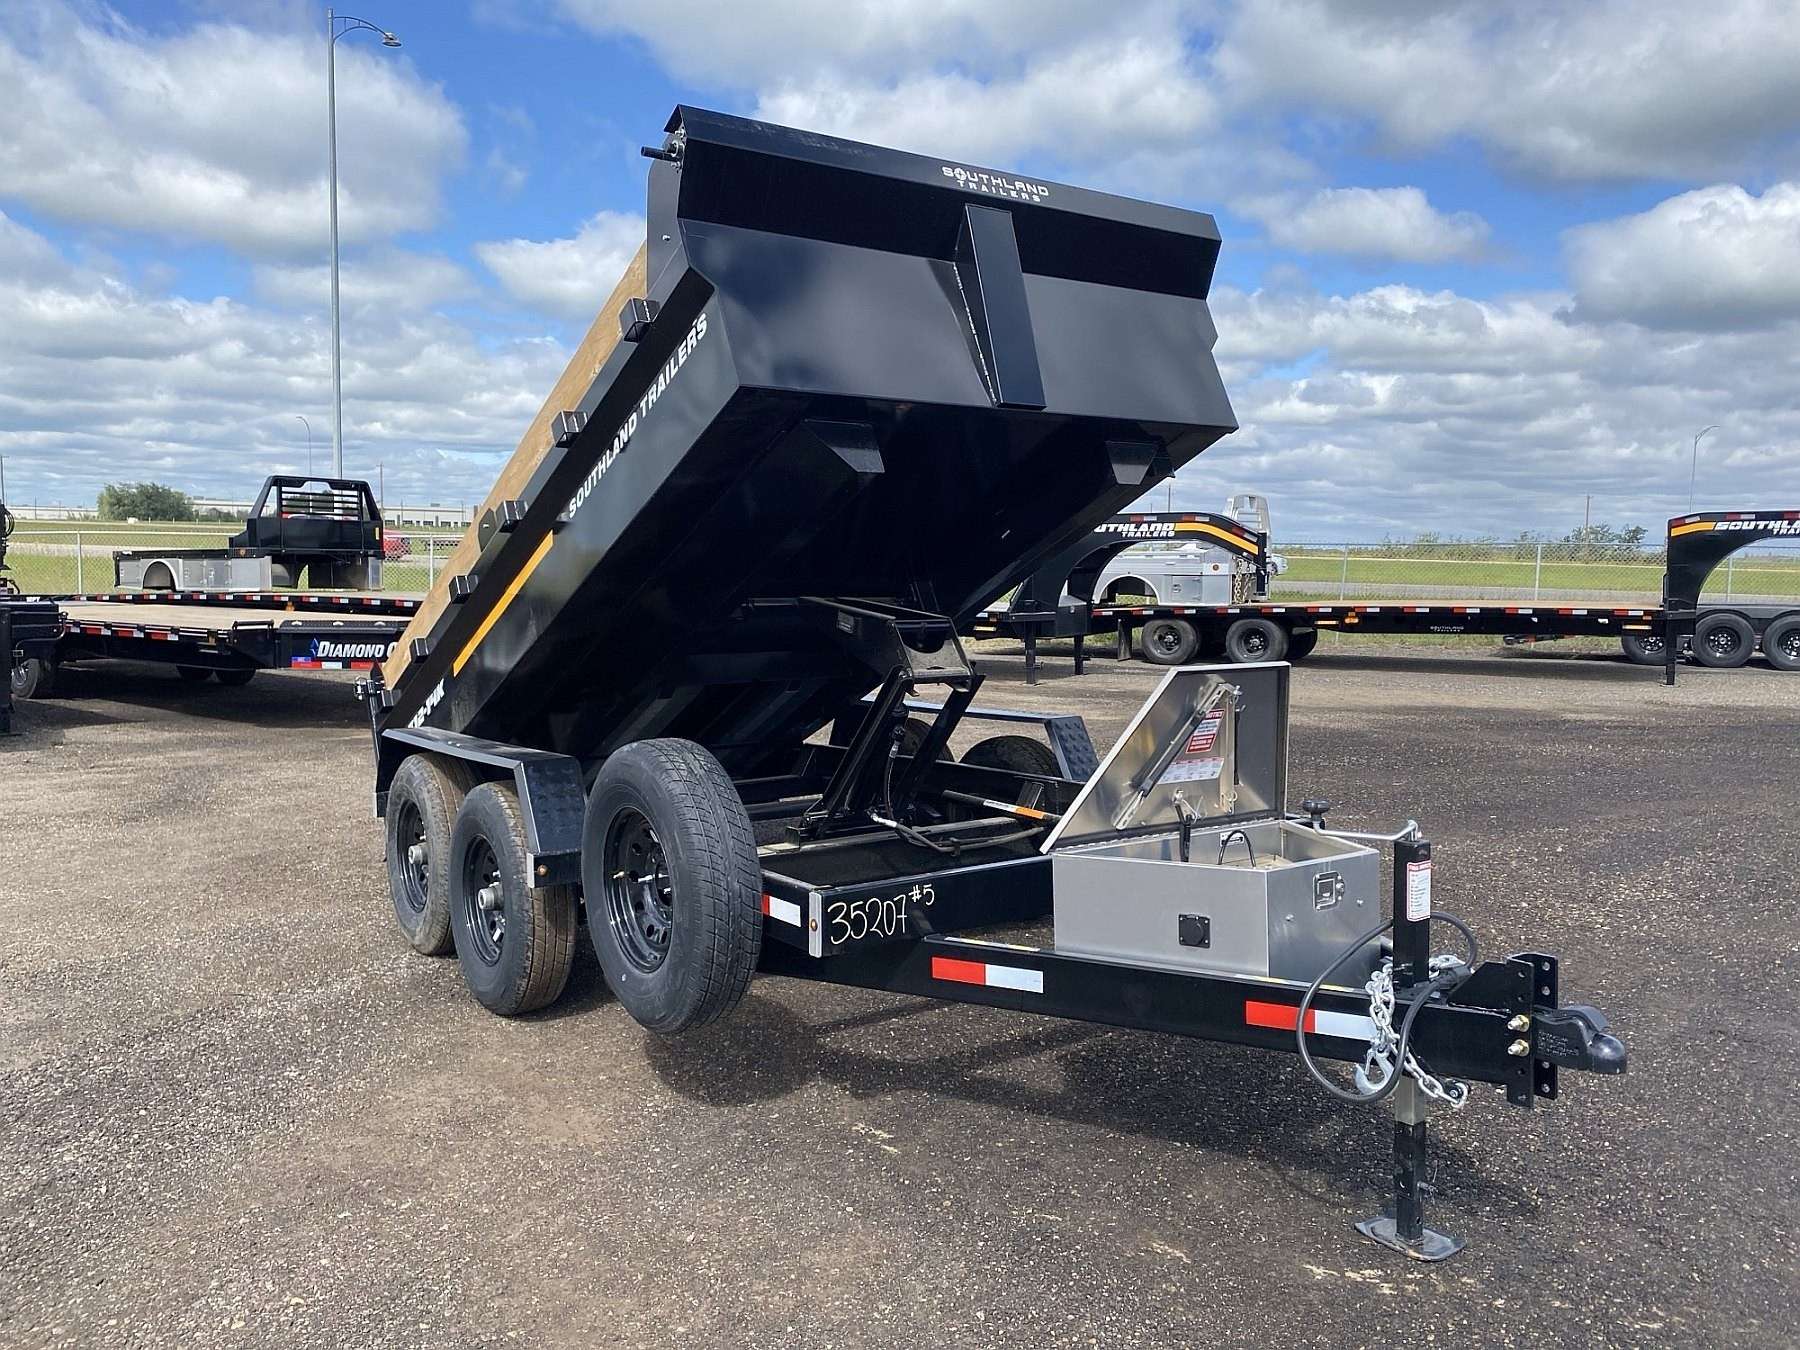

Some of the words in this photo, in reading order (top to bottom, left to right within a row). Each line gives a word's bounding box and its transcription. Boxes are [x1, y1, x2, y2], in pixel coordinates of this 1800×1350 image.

[941, 166, 1049, 196] SOUTHLAND
[957, 179, 1041, 202] TRAILERS
[569, 411, 638, 519] SOUTHLAND
[639, 312, 708, 418] TRAILERS
[1093, 522, 1175, 533] UTHLAND
[827, 894, 908, 945] 35207
[908, 884, 935, 906] #5
